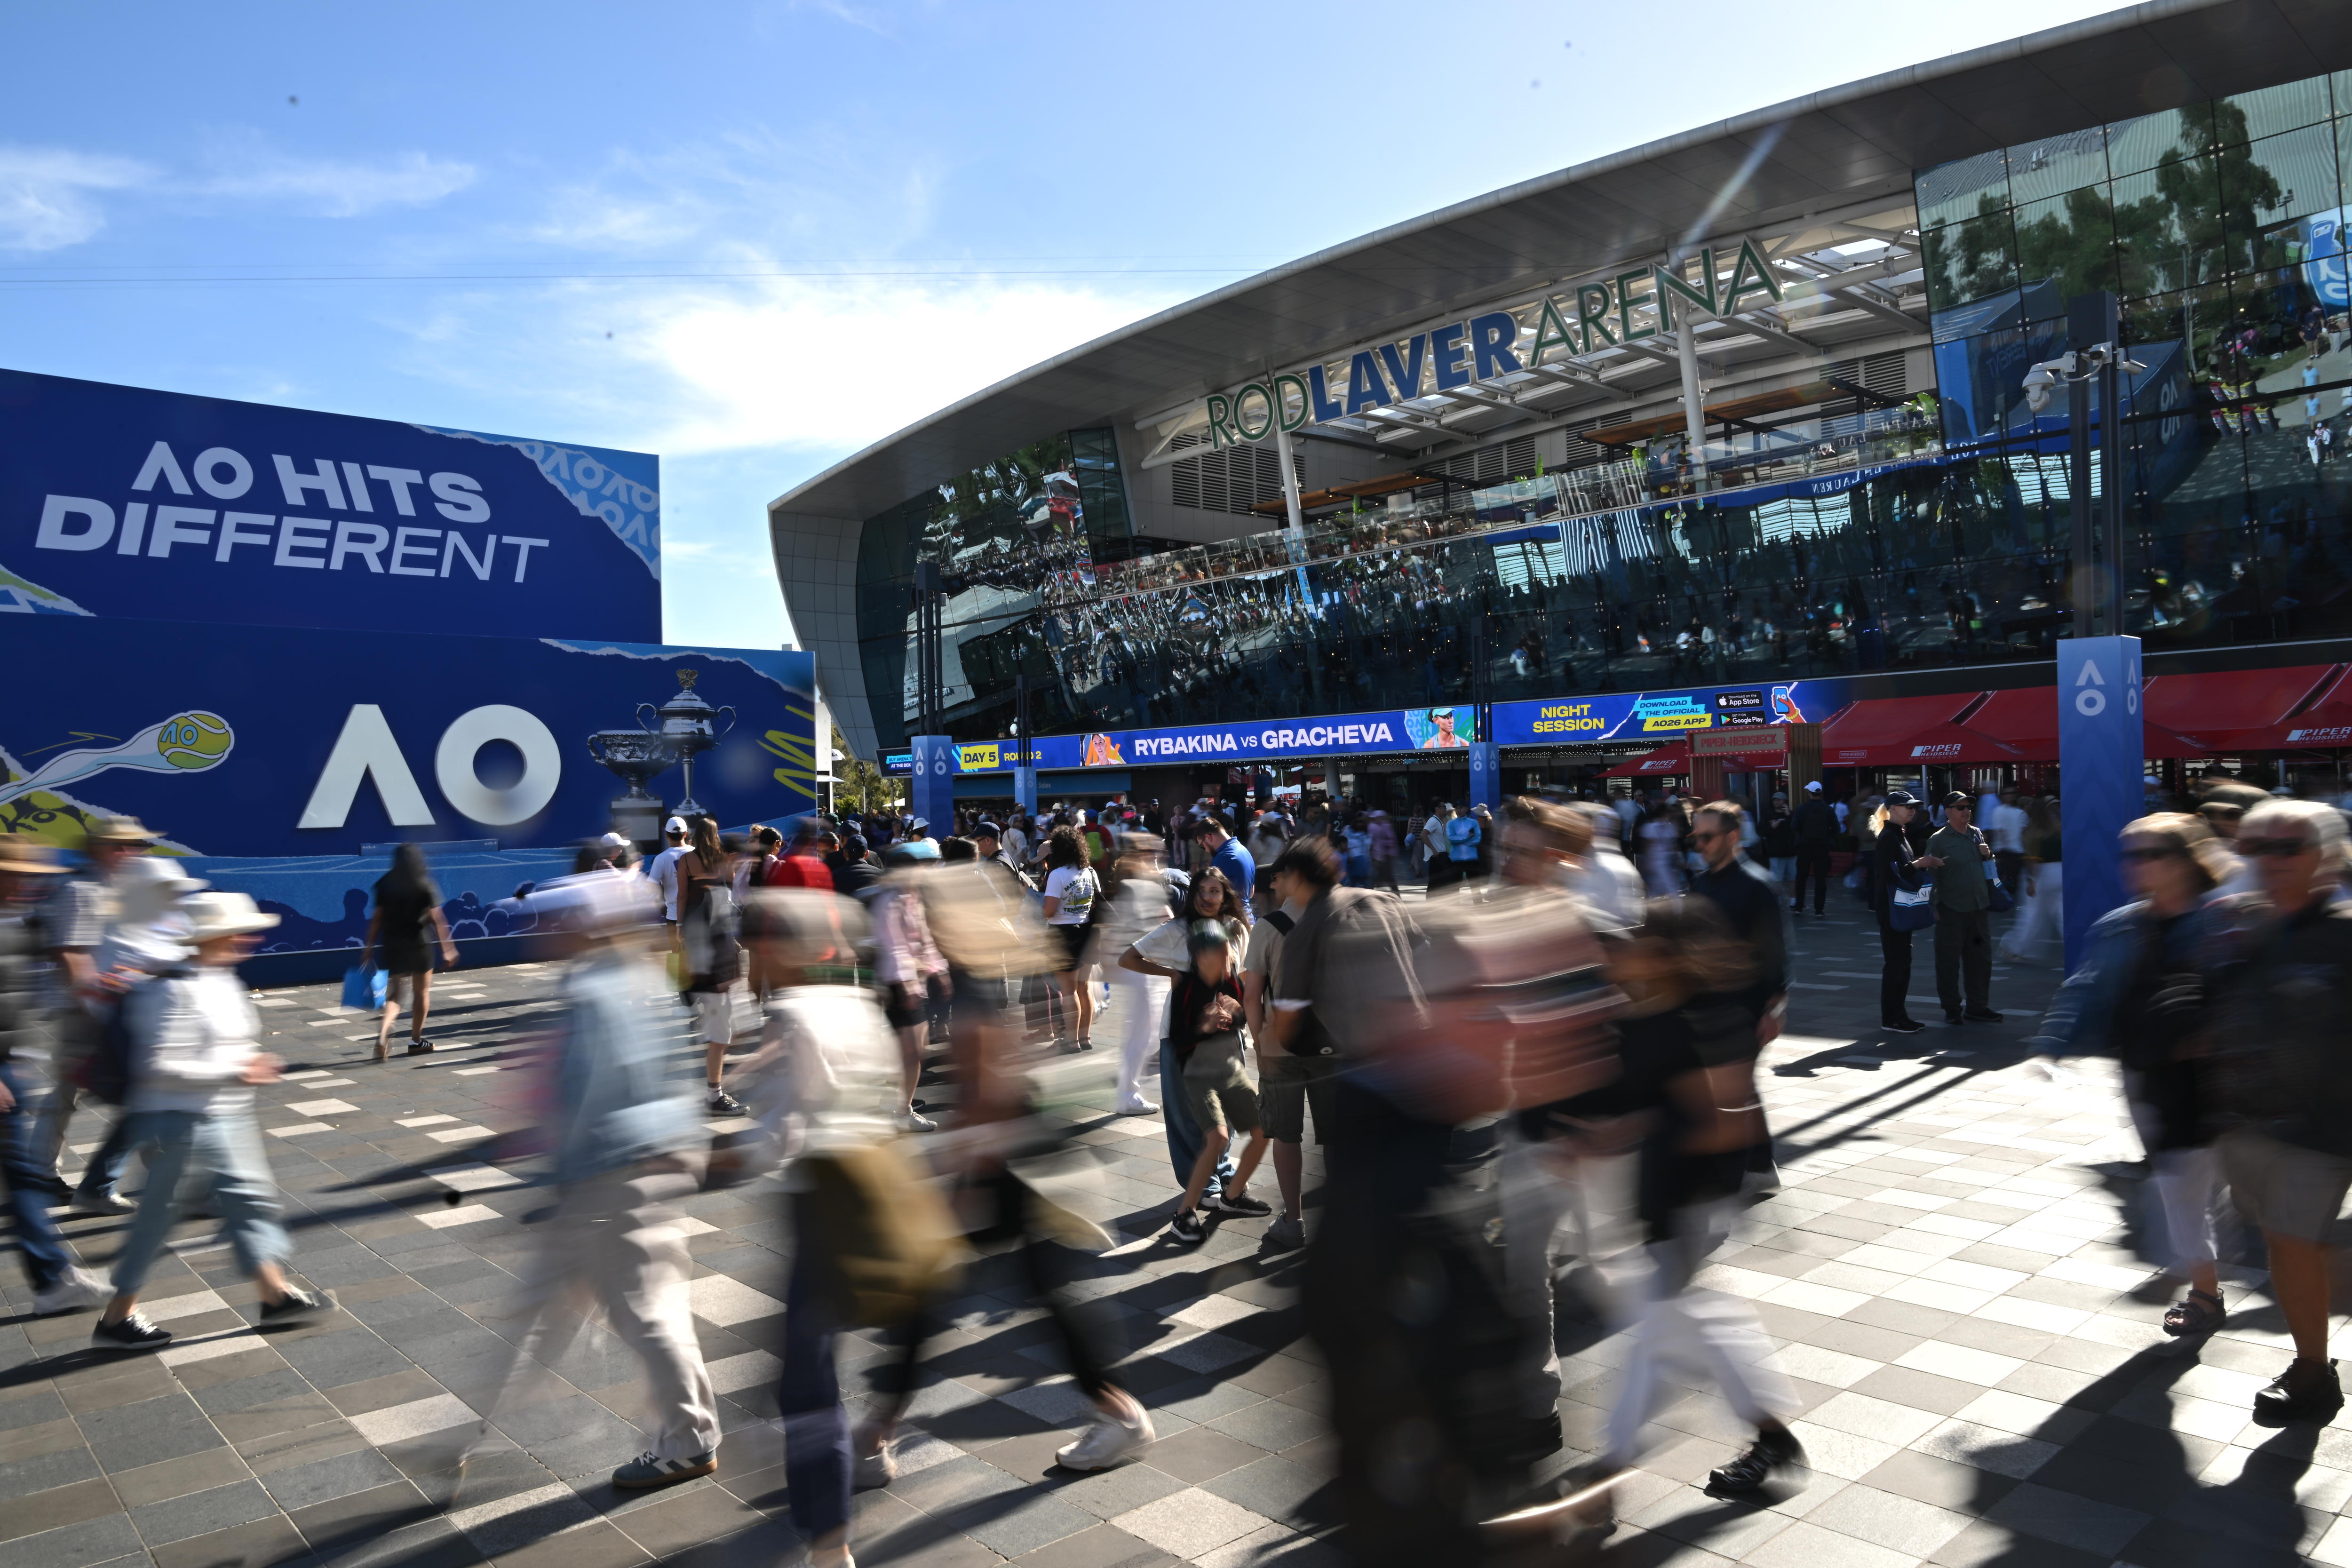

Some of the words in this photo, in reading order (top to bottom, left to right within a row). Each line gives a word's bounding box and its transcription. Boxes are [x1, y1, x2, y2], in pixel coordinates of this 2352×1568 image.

[1207, 373, 1310, 450] ROD
[1307, 310, 1527, 426] LAVER
[1529, 234, 1785, 368] ARENA
[131, 441, 254, 499] AO
[272, 454, 491, 523] HITS
[35, 494, 550, 583] DIFFERENT
[2075, 659, 2105, 716] AO
[2127, 658, 2137, 715] AO
[1541, 704, 1591, 718] NIGHT
[1533, 717, 1605, 733] SESSION
[1652, 719, 1681, 727] AO26
[2302, 727, 2352, 736] PIPER
[160, 723, 199, 745] AO
[1135, 733, 1237, 756] RYBAKINA
[1262, 723, 1393, 749] GRACHEVA
[1700, 734, 1777, 748] PIPER-HEIDSIECK
[964, 752, 985, 763] DAY
[989, 752, 996, 762] 5
[1036, 751, 1042, 759] 2
[1923, 744, 1962, 752] PIPER
[296, 704, 561, 829] AO
